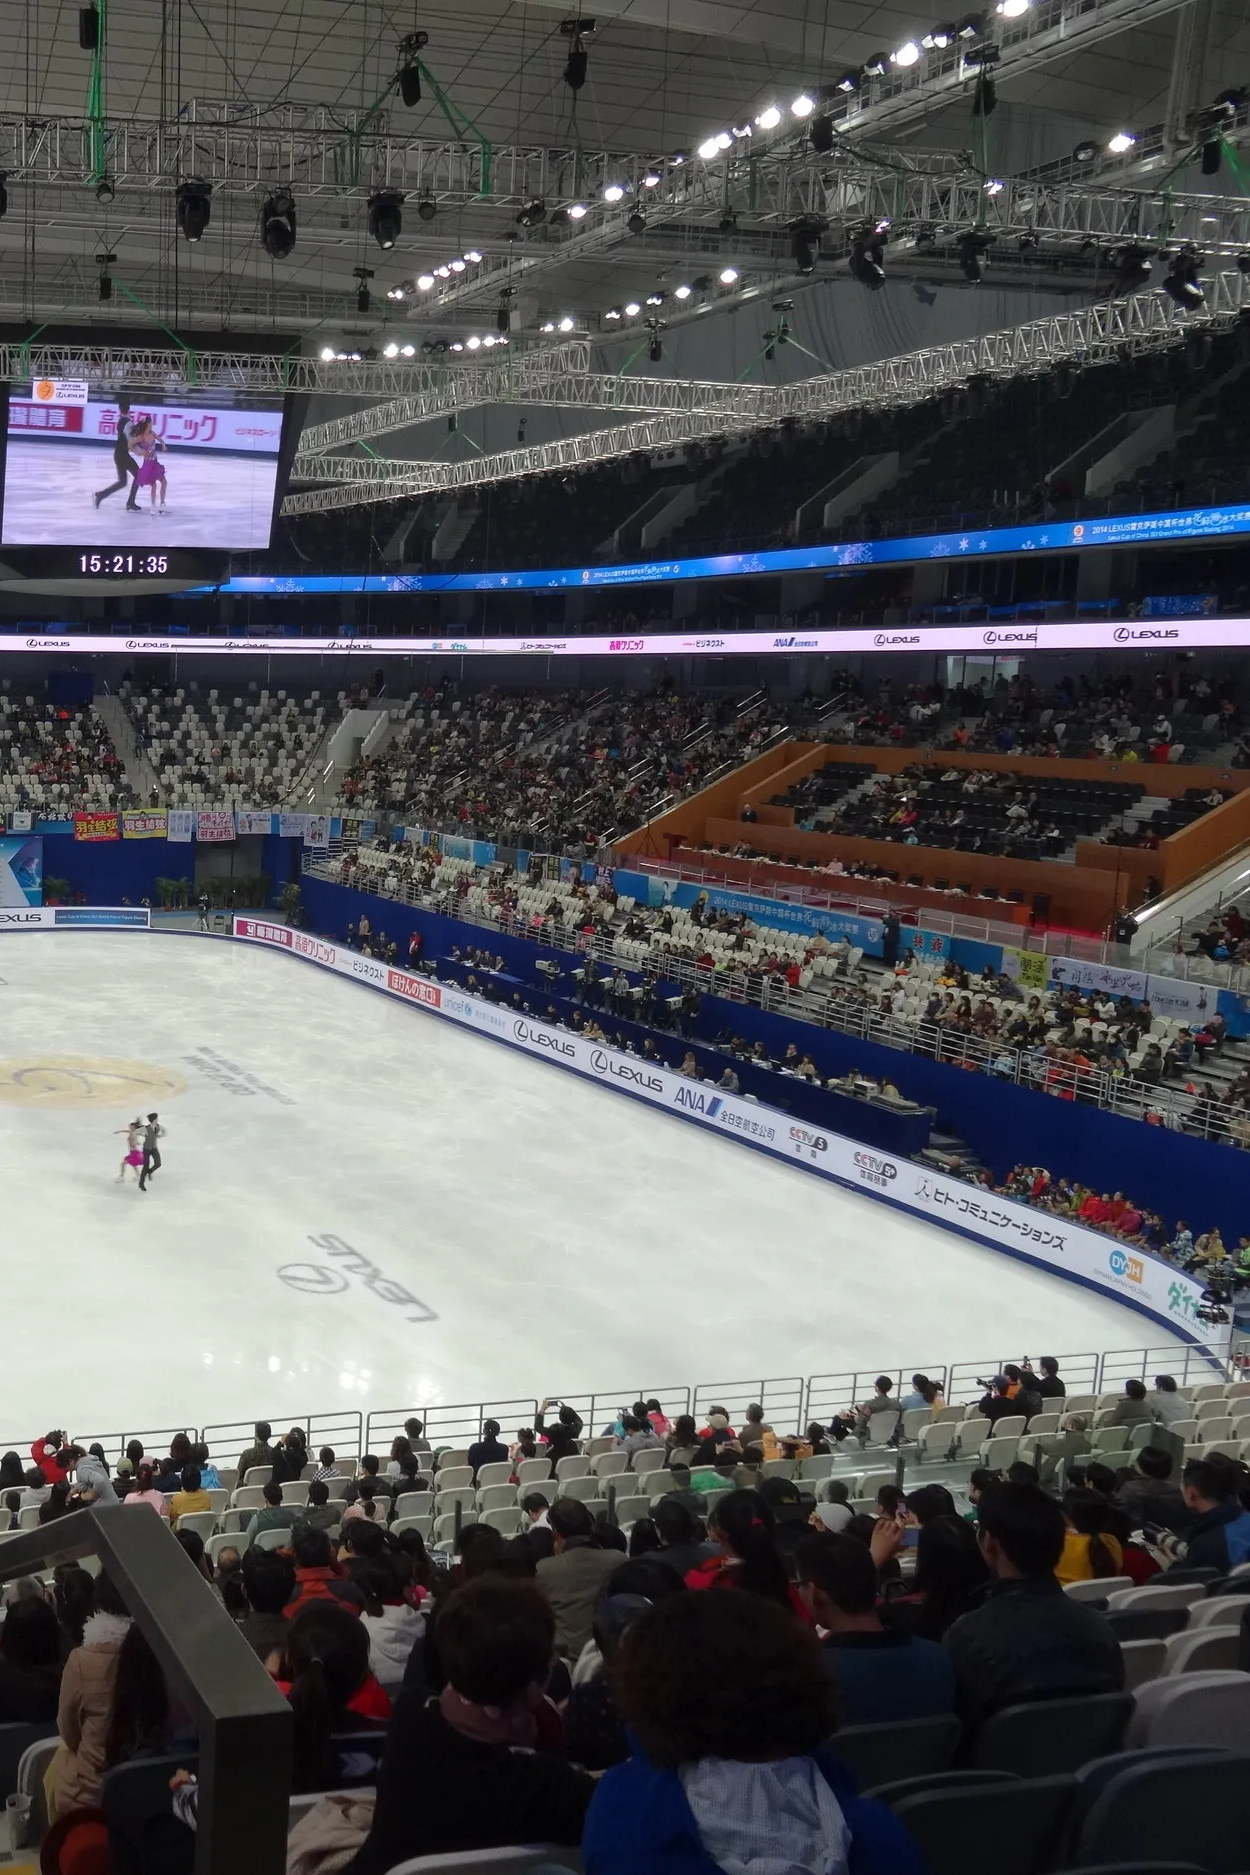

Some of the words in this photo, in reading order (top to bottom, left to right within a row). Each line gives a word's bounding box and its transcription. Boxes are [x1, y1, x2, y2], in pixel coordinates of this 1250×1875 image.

[79, 555, 168, 574] 15:21:35
[38, 639, 70, 648] LEXUS
[886, 635, 920, 645] LEXUS
[998, 633, 1037, 643] LEXUS
[1130, 629, 1179, 640] LEXUS
[137, 642, 169, 650] LEXUS
[352, 959, 384, 982] ビジネクスト
[444, 996, 465, 1013] unicef
[530, 1030, 576, 1059] LEXUS
[609, 1061, 663, 1093] LEXUS
[673, 1086, 705, 1114] ANA
[719, 1110, 776, 1142] 全日空航空公司
[933, 1188, 1068, 1252] ヒト・コミュニケーションズ
[307, 1233, 439, 1323] LEXUS
